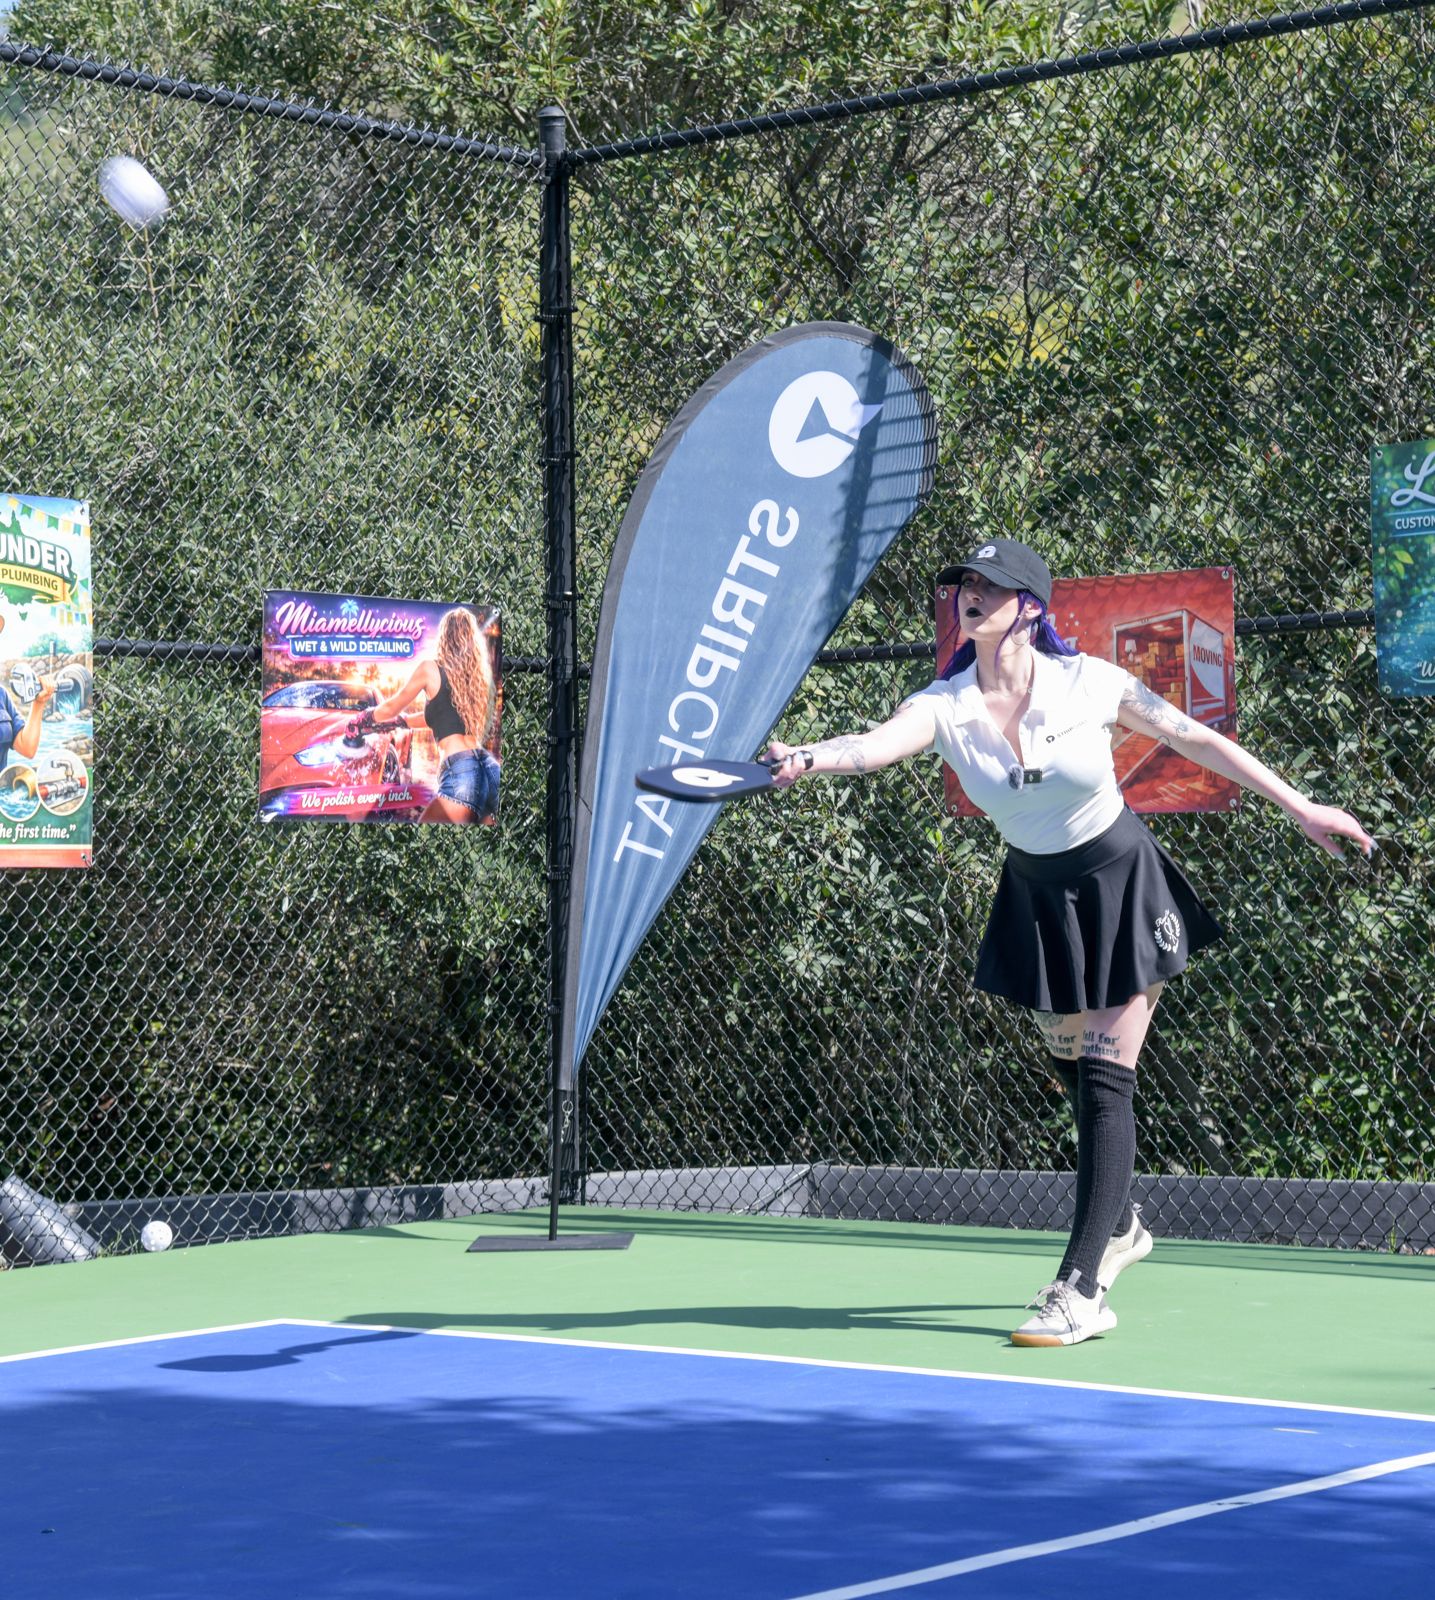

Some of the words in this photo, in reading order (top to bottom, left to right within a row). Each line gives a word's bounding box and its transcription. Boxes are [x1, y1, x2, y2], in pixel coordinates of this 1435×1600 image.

[1, 568, 58, 591] PLUMBING
[275, 601, 426, 640] Miamellycious
[294, 641, 317, 652] WET
[319, 641, 328, 652] &
[329, 641, 358, 653] WILD
[360, 641, 411, 653] DETAILING
[1193, 644, 1223, 667] MOVING
[301, 792, 321, 808] We
[321, 790, 355, 811] polish
[357, 794, 387, 808] every
[388, 786, 413, 802] inch.
[12, 823, 40, 843] first
